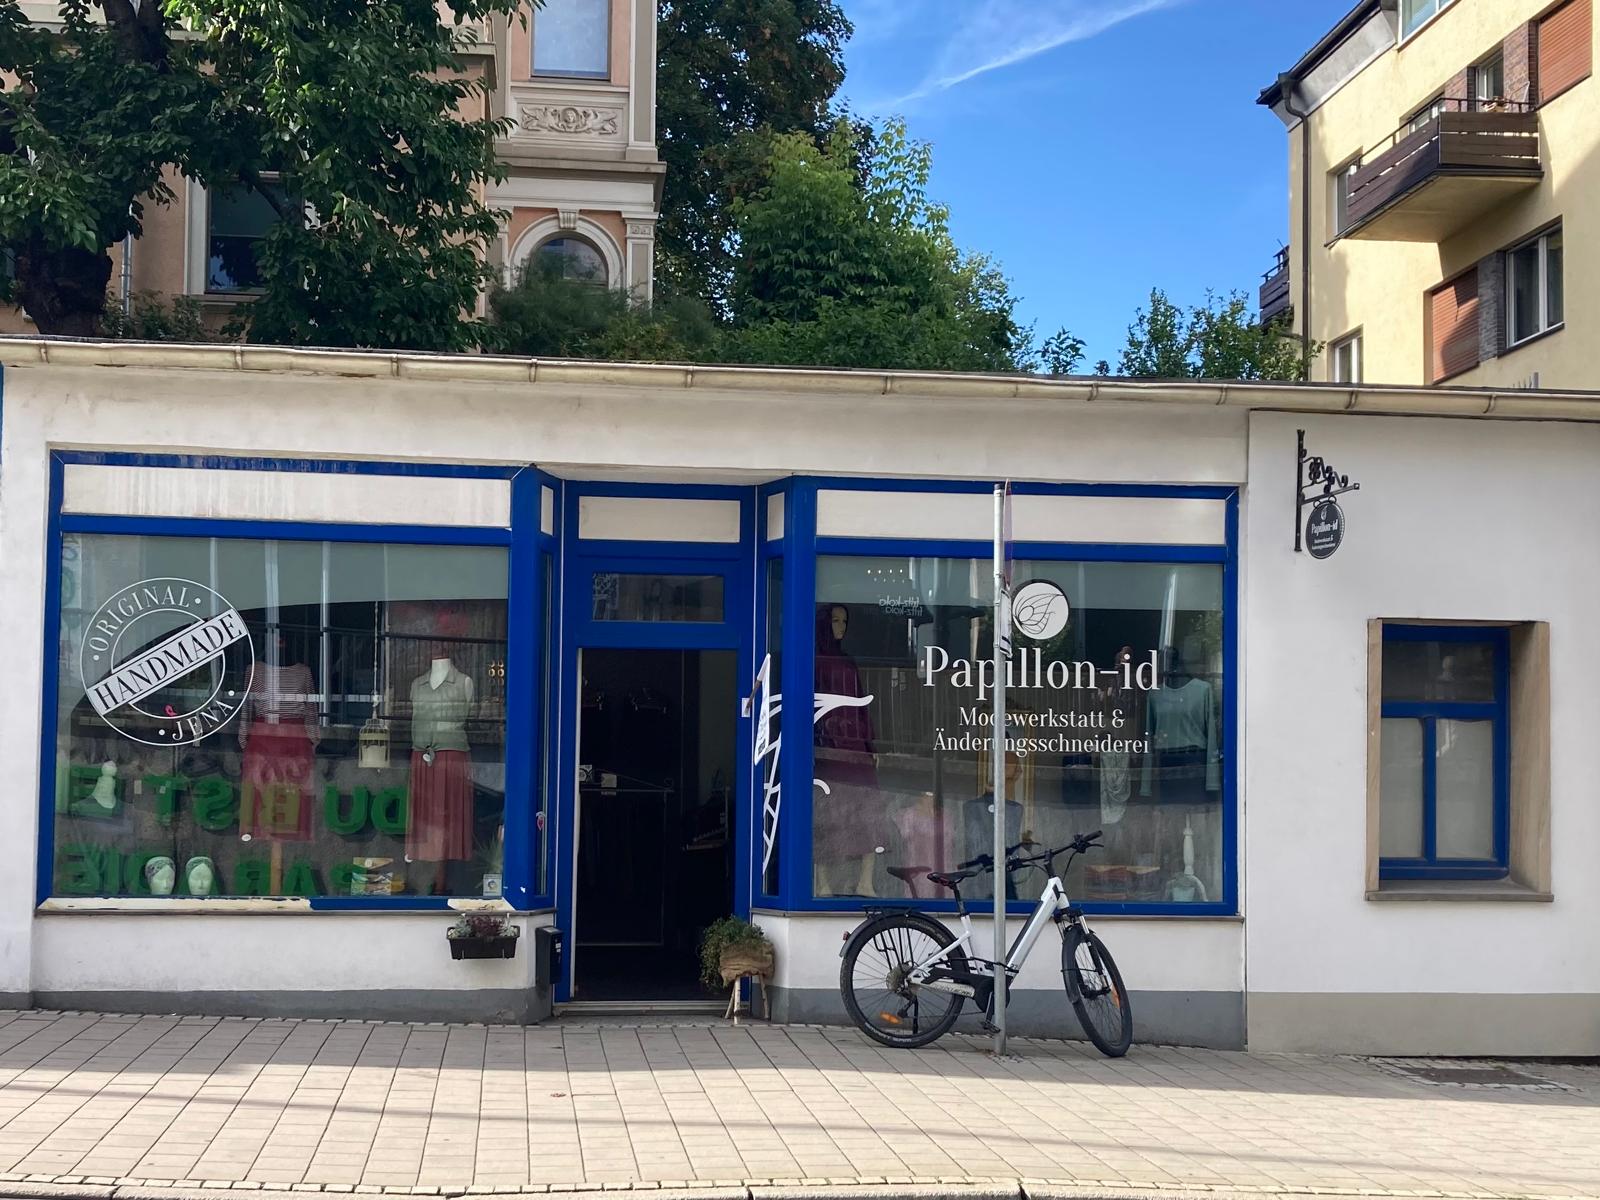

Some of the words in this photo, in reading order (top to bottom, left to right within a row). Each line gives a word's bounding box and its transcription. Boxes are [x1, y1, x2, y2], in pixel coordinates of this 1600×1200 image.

[89, 585, 190, 652] ORIGINAL
[94, 613, 242, 711] HANDMADE
[923, 645, 1160, 701] Papillon-id
[172, 700, 234, 741] JENA
[1112, 708, 1126, 729] &
[933, 728, 1150, 758] Änderngsschneiderei
